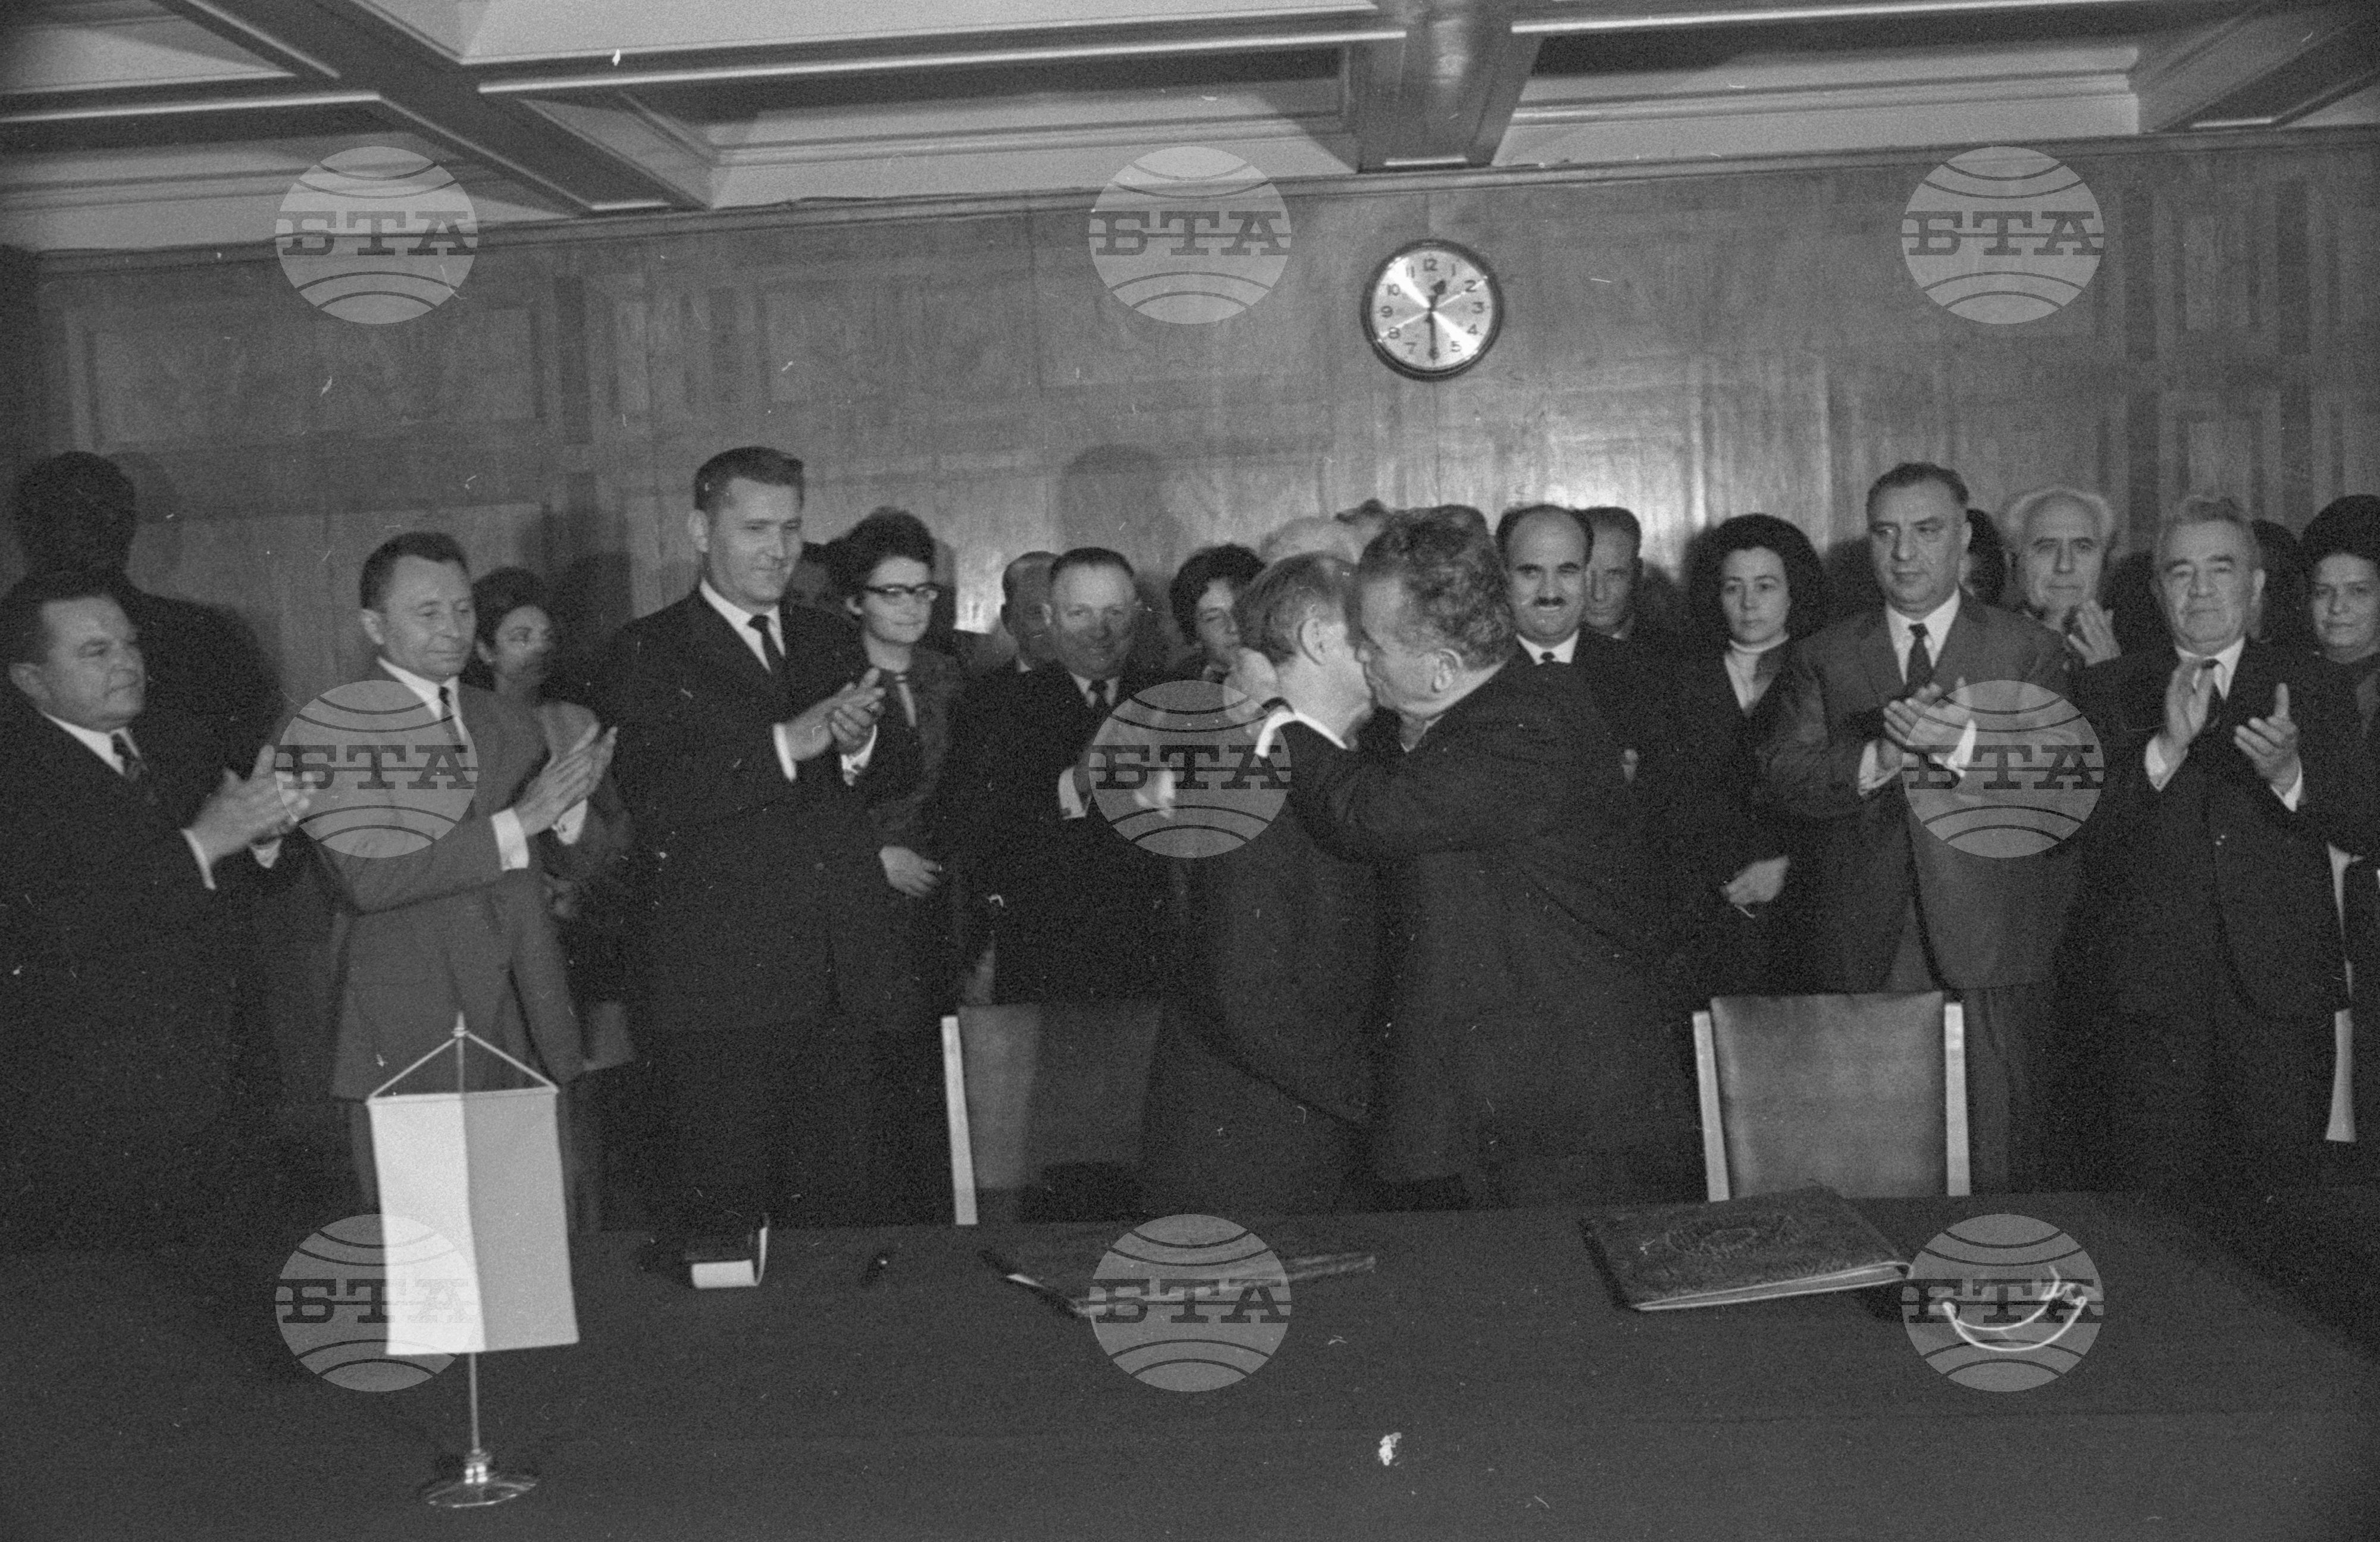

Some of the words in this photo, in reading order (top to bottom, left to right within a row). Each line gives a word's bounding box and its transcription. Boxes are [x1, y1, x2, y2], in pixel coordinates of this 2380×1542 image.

[1423, 258, 1438, 271] 12
[1388, 283, 1401, 296] 10
[1464, 279, 1477, 293] 2
[1380, 305, 1393, 318] 9
[1471, 301, 1484, 314] 3
[1388, 327, 1401, 339] 8
[1467, 324, 1478, 335] 4
[1404, 342, 1417, 354] 7
[1451, 340, 1461, 352] 5
